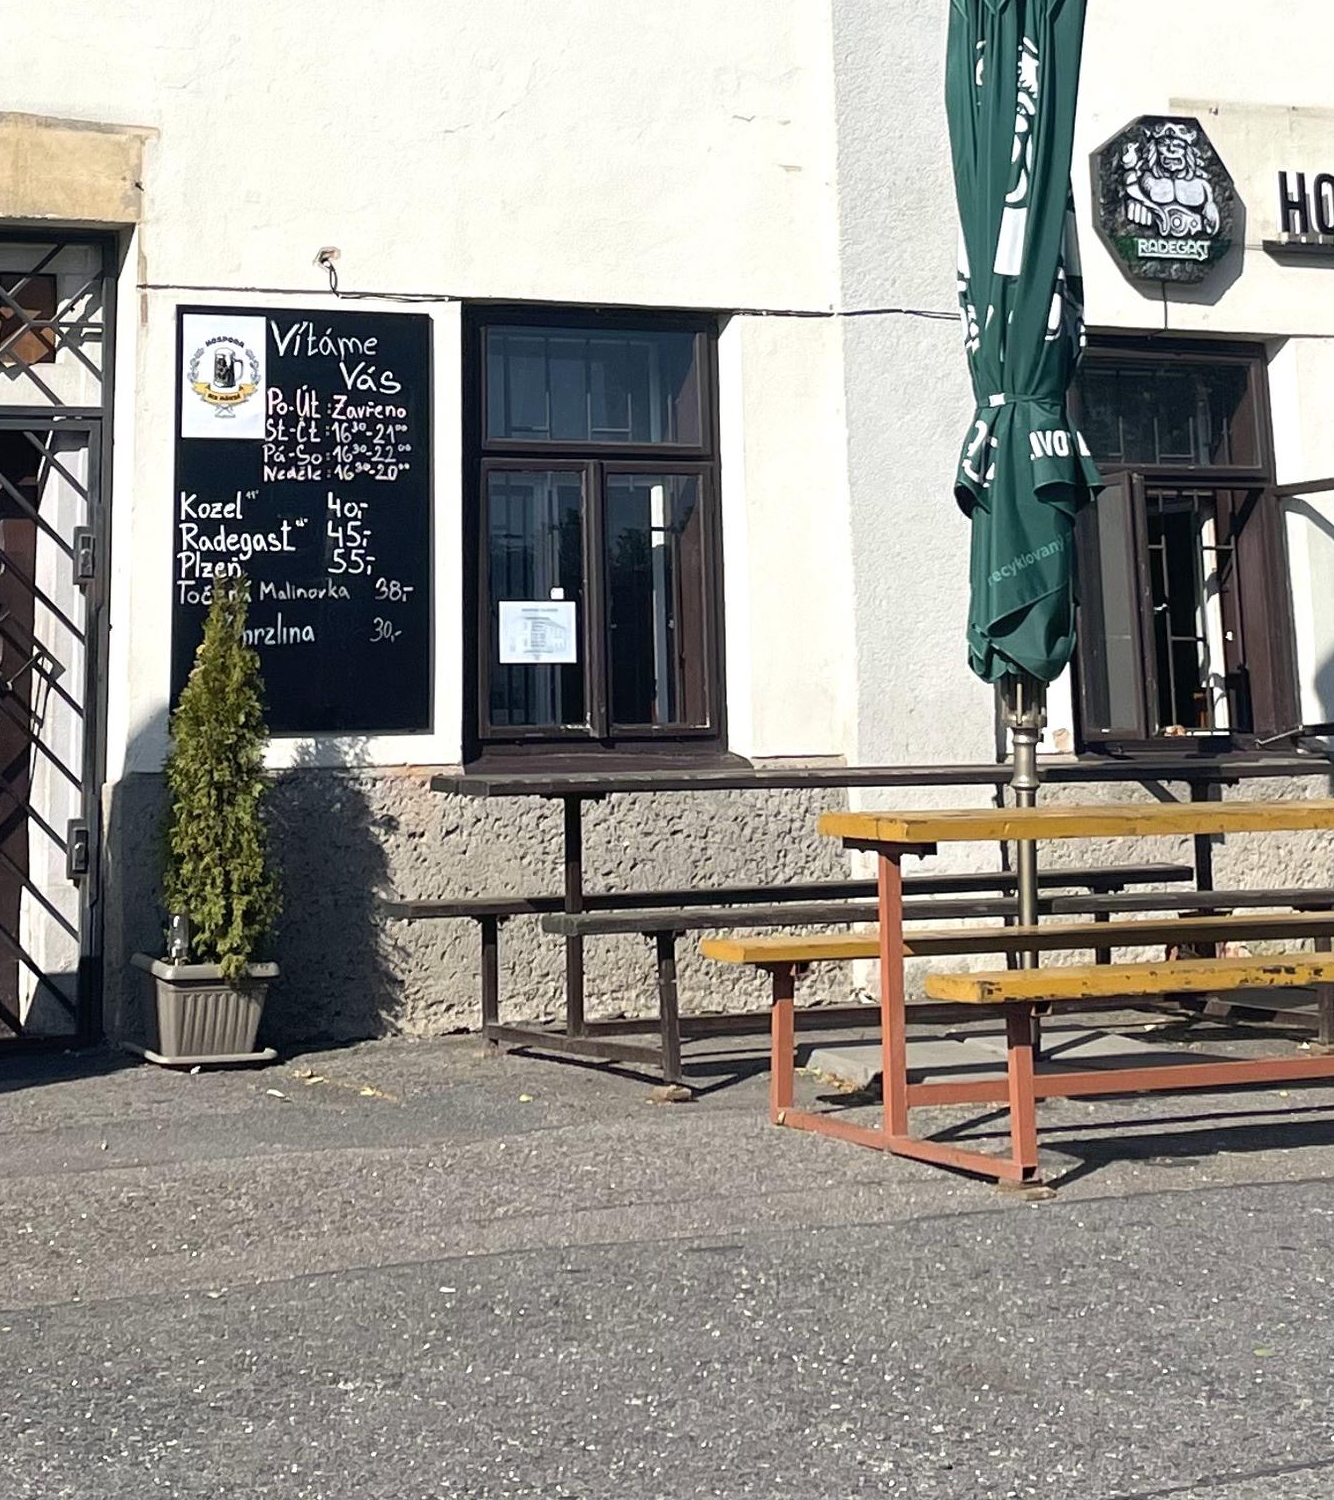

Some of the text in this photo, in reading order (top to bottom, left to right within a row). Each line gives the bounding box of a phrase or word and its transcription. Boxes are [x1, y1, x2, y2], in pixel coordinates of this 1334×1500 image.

[1137, 237, 1211, 261] RADEGAST
[271, 320, 377, 360] Vítáme
[339, 361, 402, 394] Vás
[180, 491, 243, 520] Kozel
[179, 520, 296, 560] Radegast
